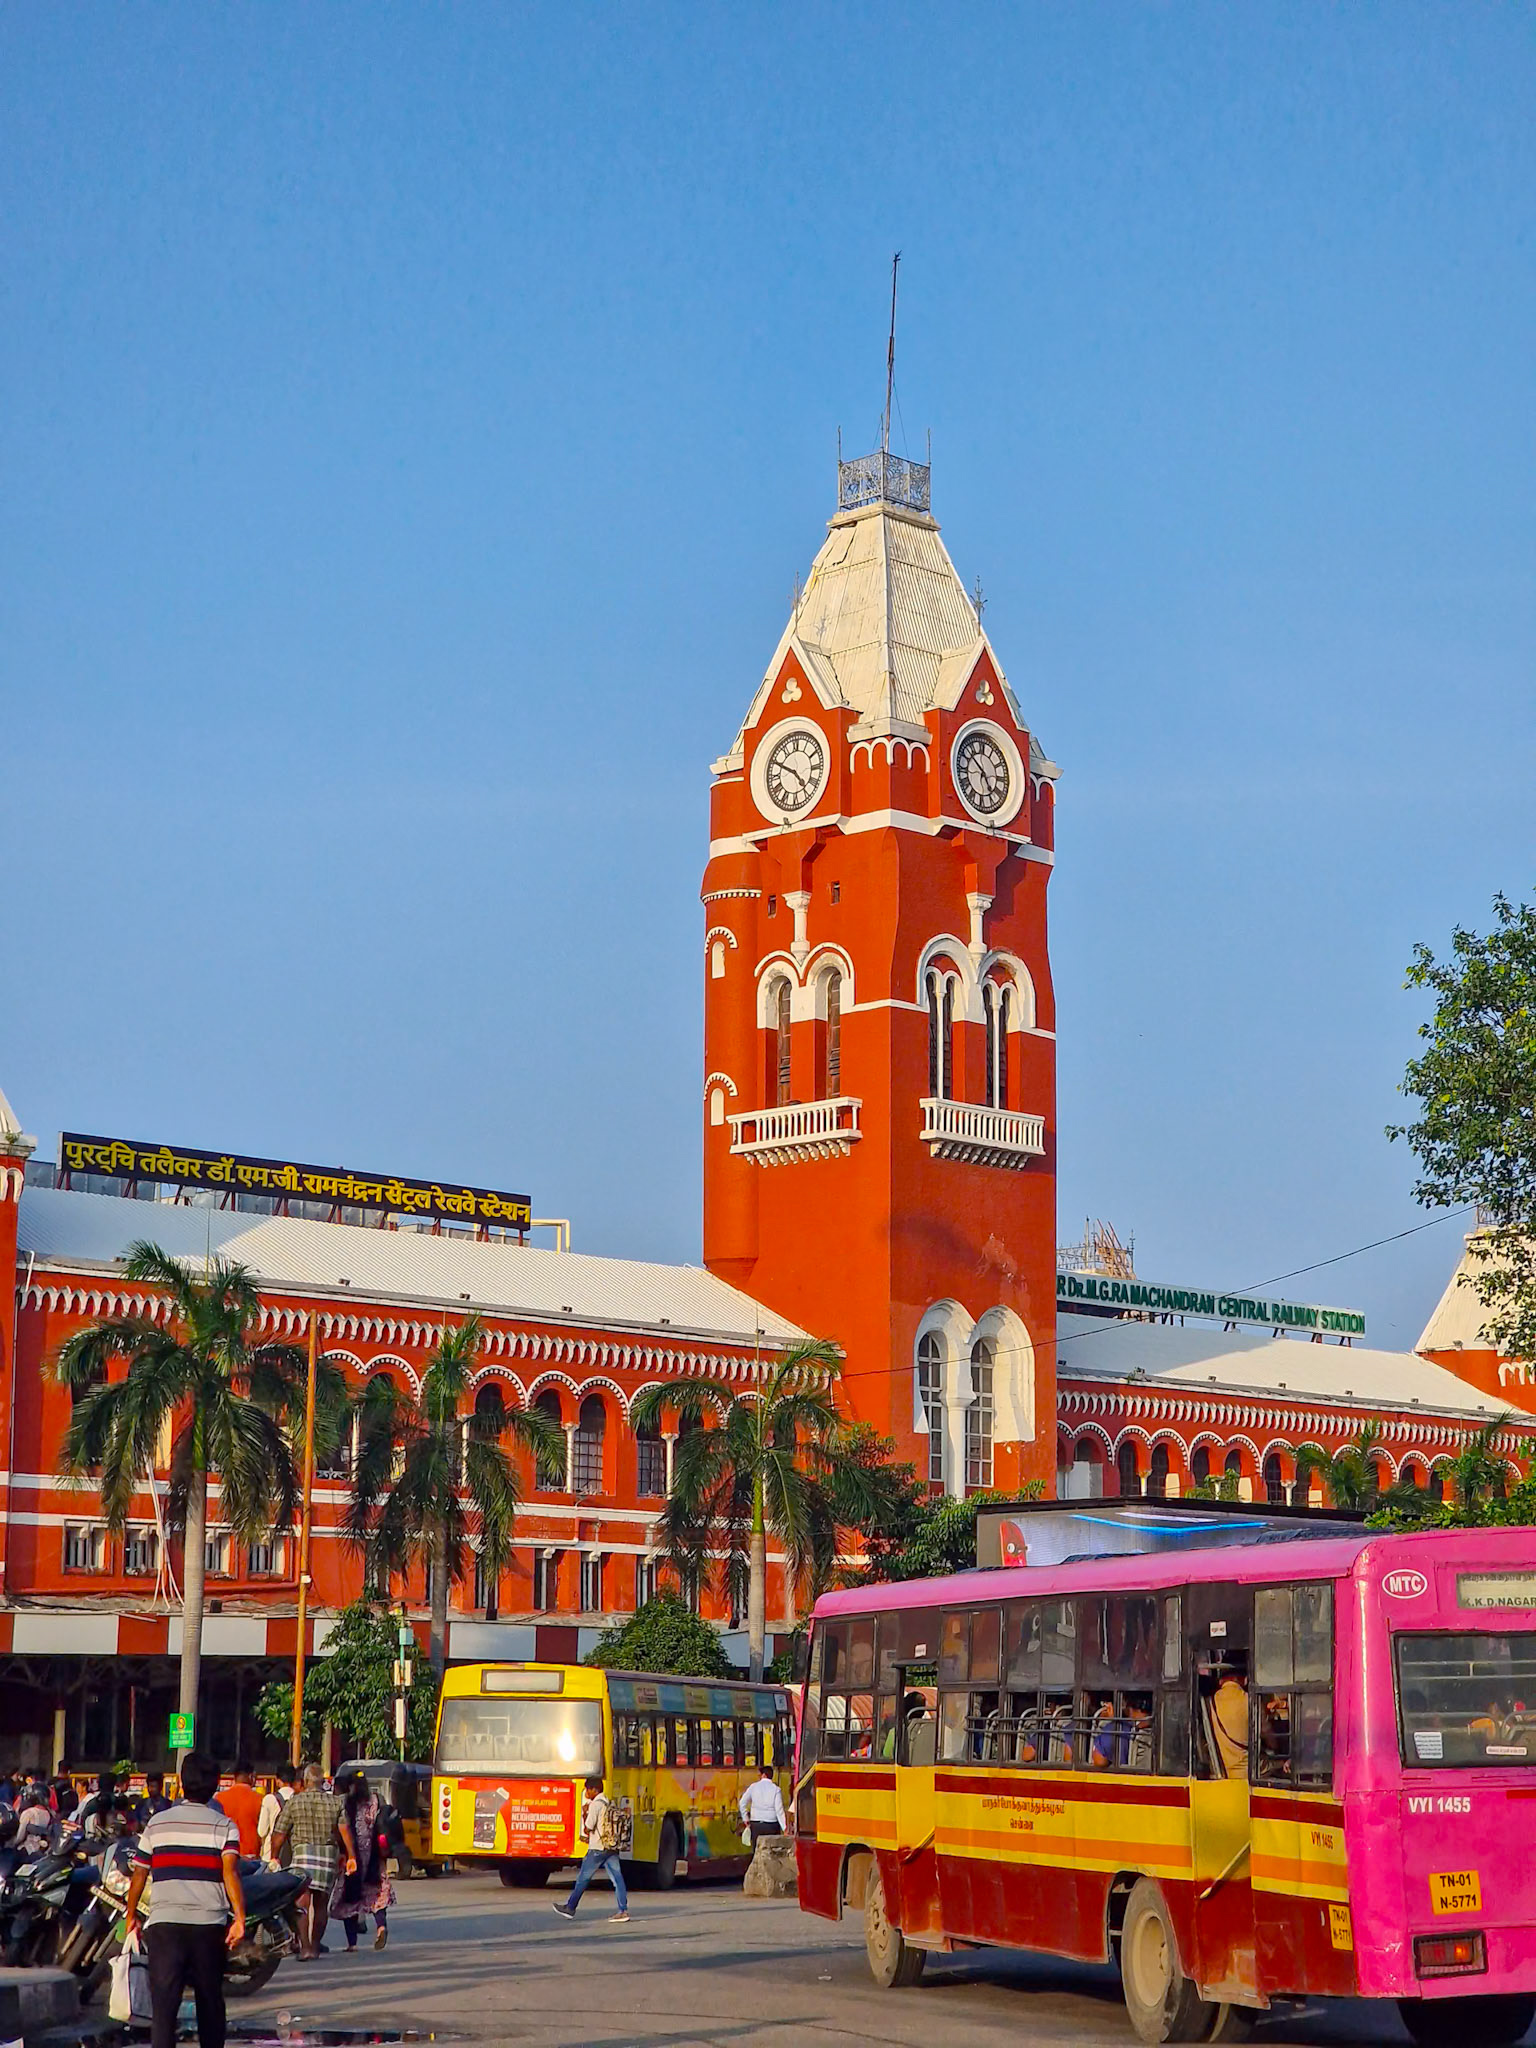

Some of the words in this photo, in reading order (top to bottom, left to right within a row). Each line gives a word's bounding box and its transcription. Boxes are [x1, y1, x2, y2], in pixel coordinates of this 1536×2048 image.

[138, 1147, 203, 1179] तलैवर
[432, 1186, 478, 1215] रेलवे
[478, 1194, 531, 1223] स्टेशन
[1218, 1296, 1270, 1322] CENTRAL
[1272, 1303, 1319, 1329] RAILWAY
[1321, 1310, 1365, 1334] STATION
[1389, 1575, 1422, 1593] MTC
[1408, 1797, 1433, 1813] VYI
[1437, 1797, 1471, 1813] 1455
[511, 1822, 535, 1831] EVENTS
[1322, 1833, 1333, 1850] 1455
[1439, 1873, 1471, 1888] TN-01
[1440, 1894, 1476, 1909] N-5771
